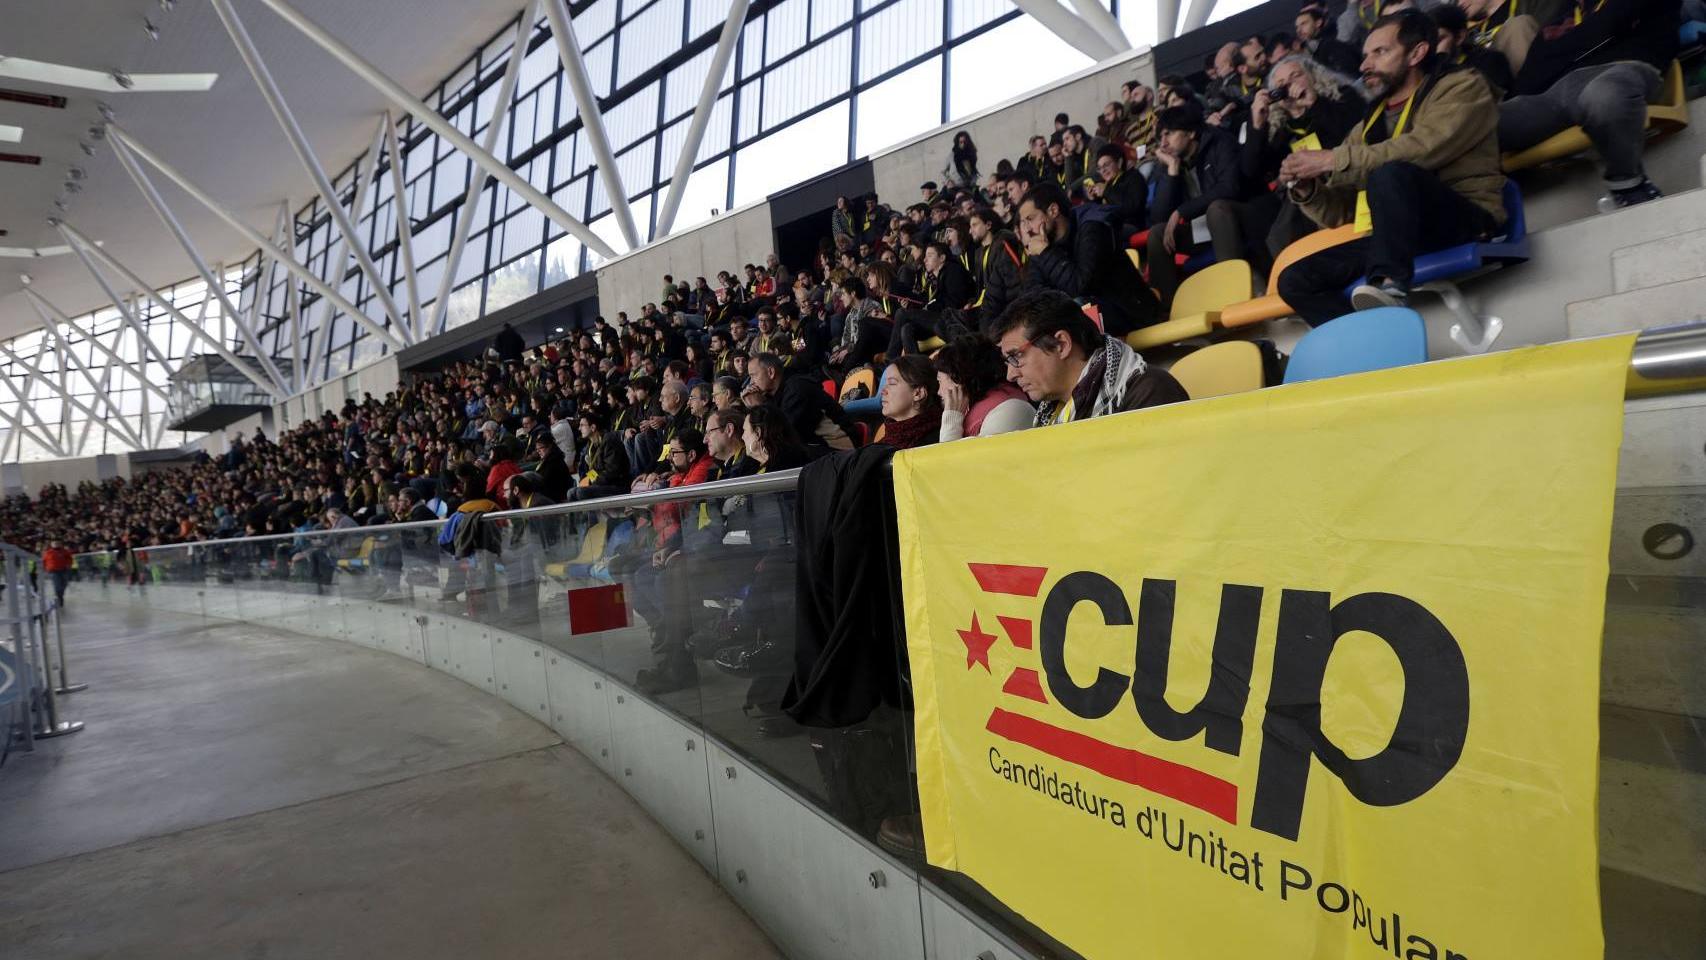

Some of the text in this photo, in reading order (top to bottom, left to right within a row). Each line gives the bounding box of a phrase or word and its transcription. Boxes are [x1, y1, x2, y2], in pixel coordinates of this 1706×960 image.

[1039, 570, 1471, 843] cup
[988, 746, 1468, 960] Candidatura d'Unitat Popula
